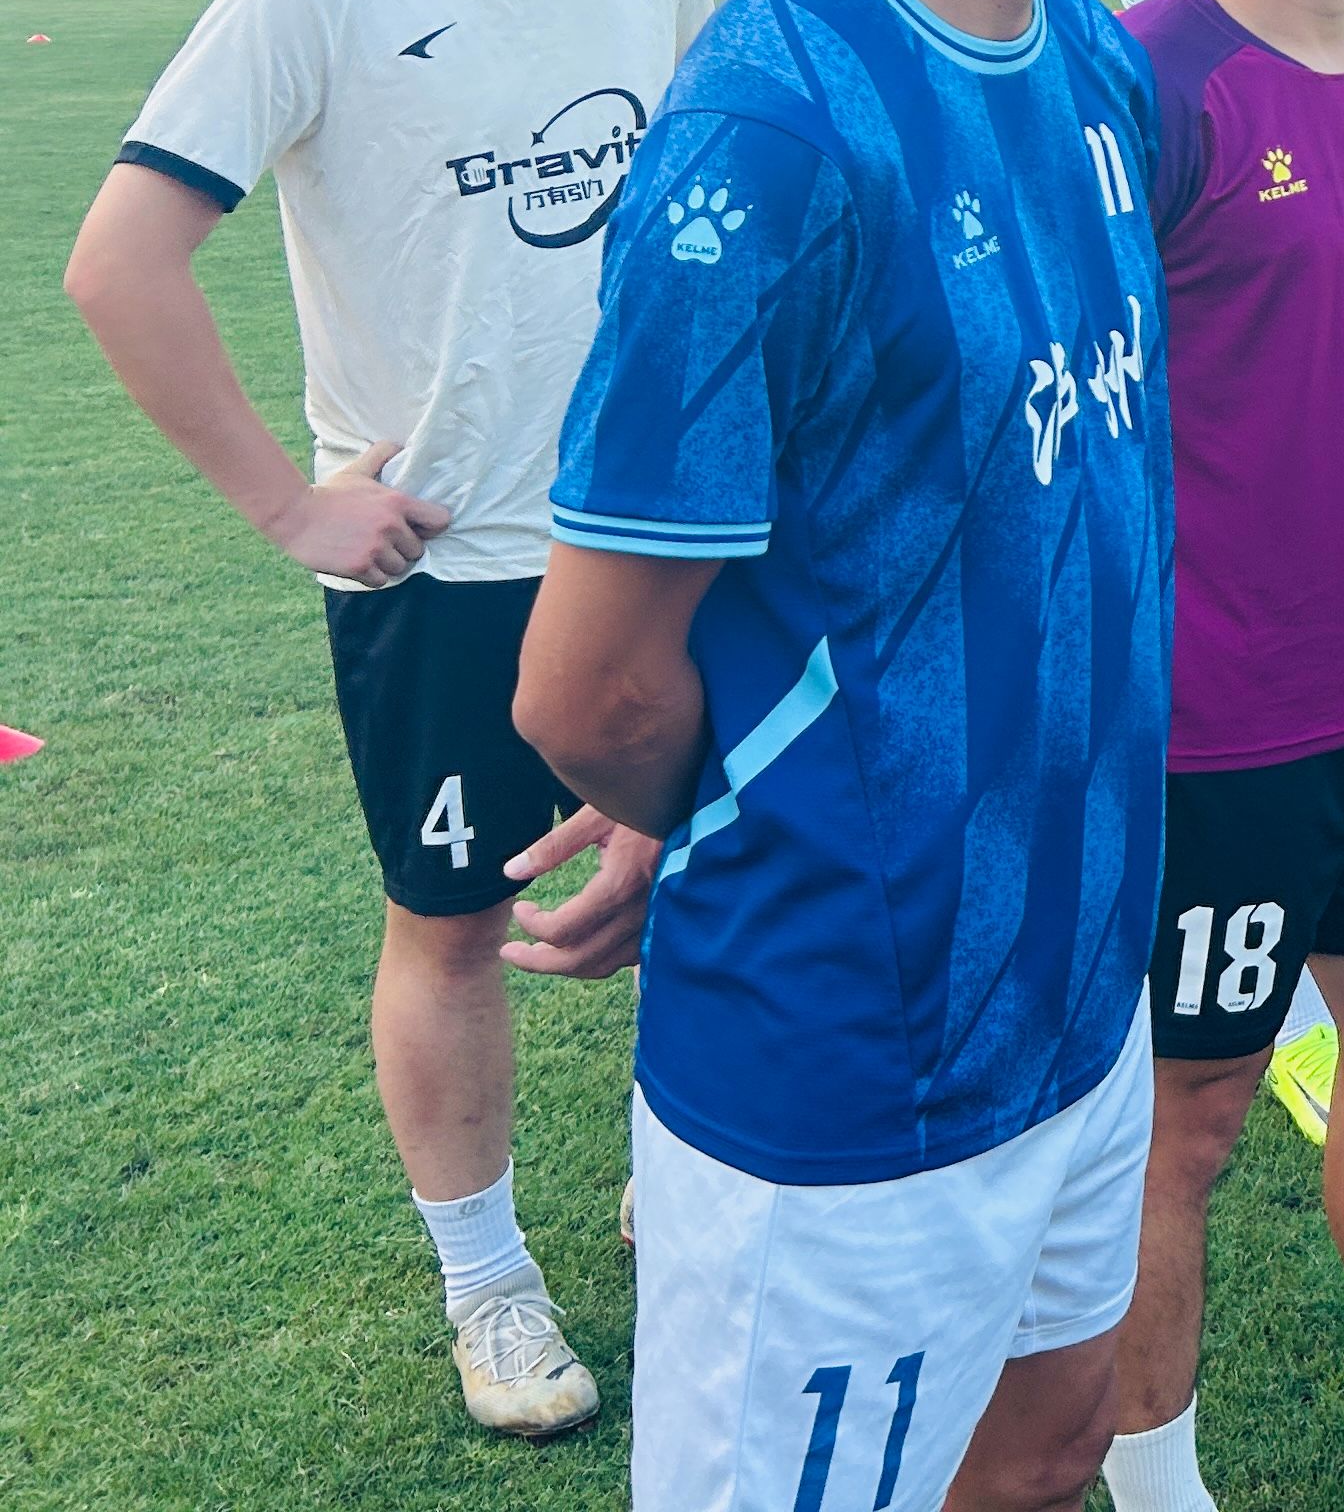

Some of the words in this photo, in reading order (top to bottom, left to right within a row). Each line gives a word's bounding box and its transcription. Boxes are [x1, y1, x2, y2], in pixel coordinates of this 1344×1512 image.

[446, 126, 640, 197] Gravit
[1258, 179, 1309, 203] KELME
[676, 242, 718, 256] KELME
[953, 235, 1002, 270] KELME
[421, 775, 475, 869] 4
[1174, 901, 1285, 1016] 18
[793, 1350, 927, 1512] 11
